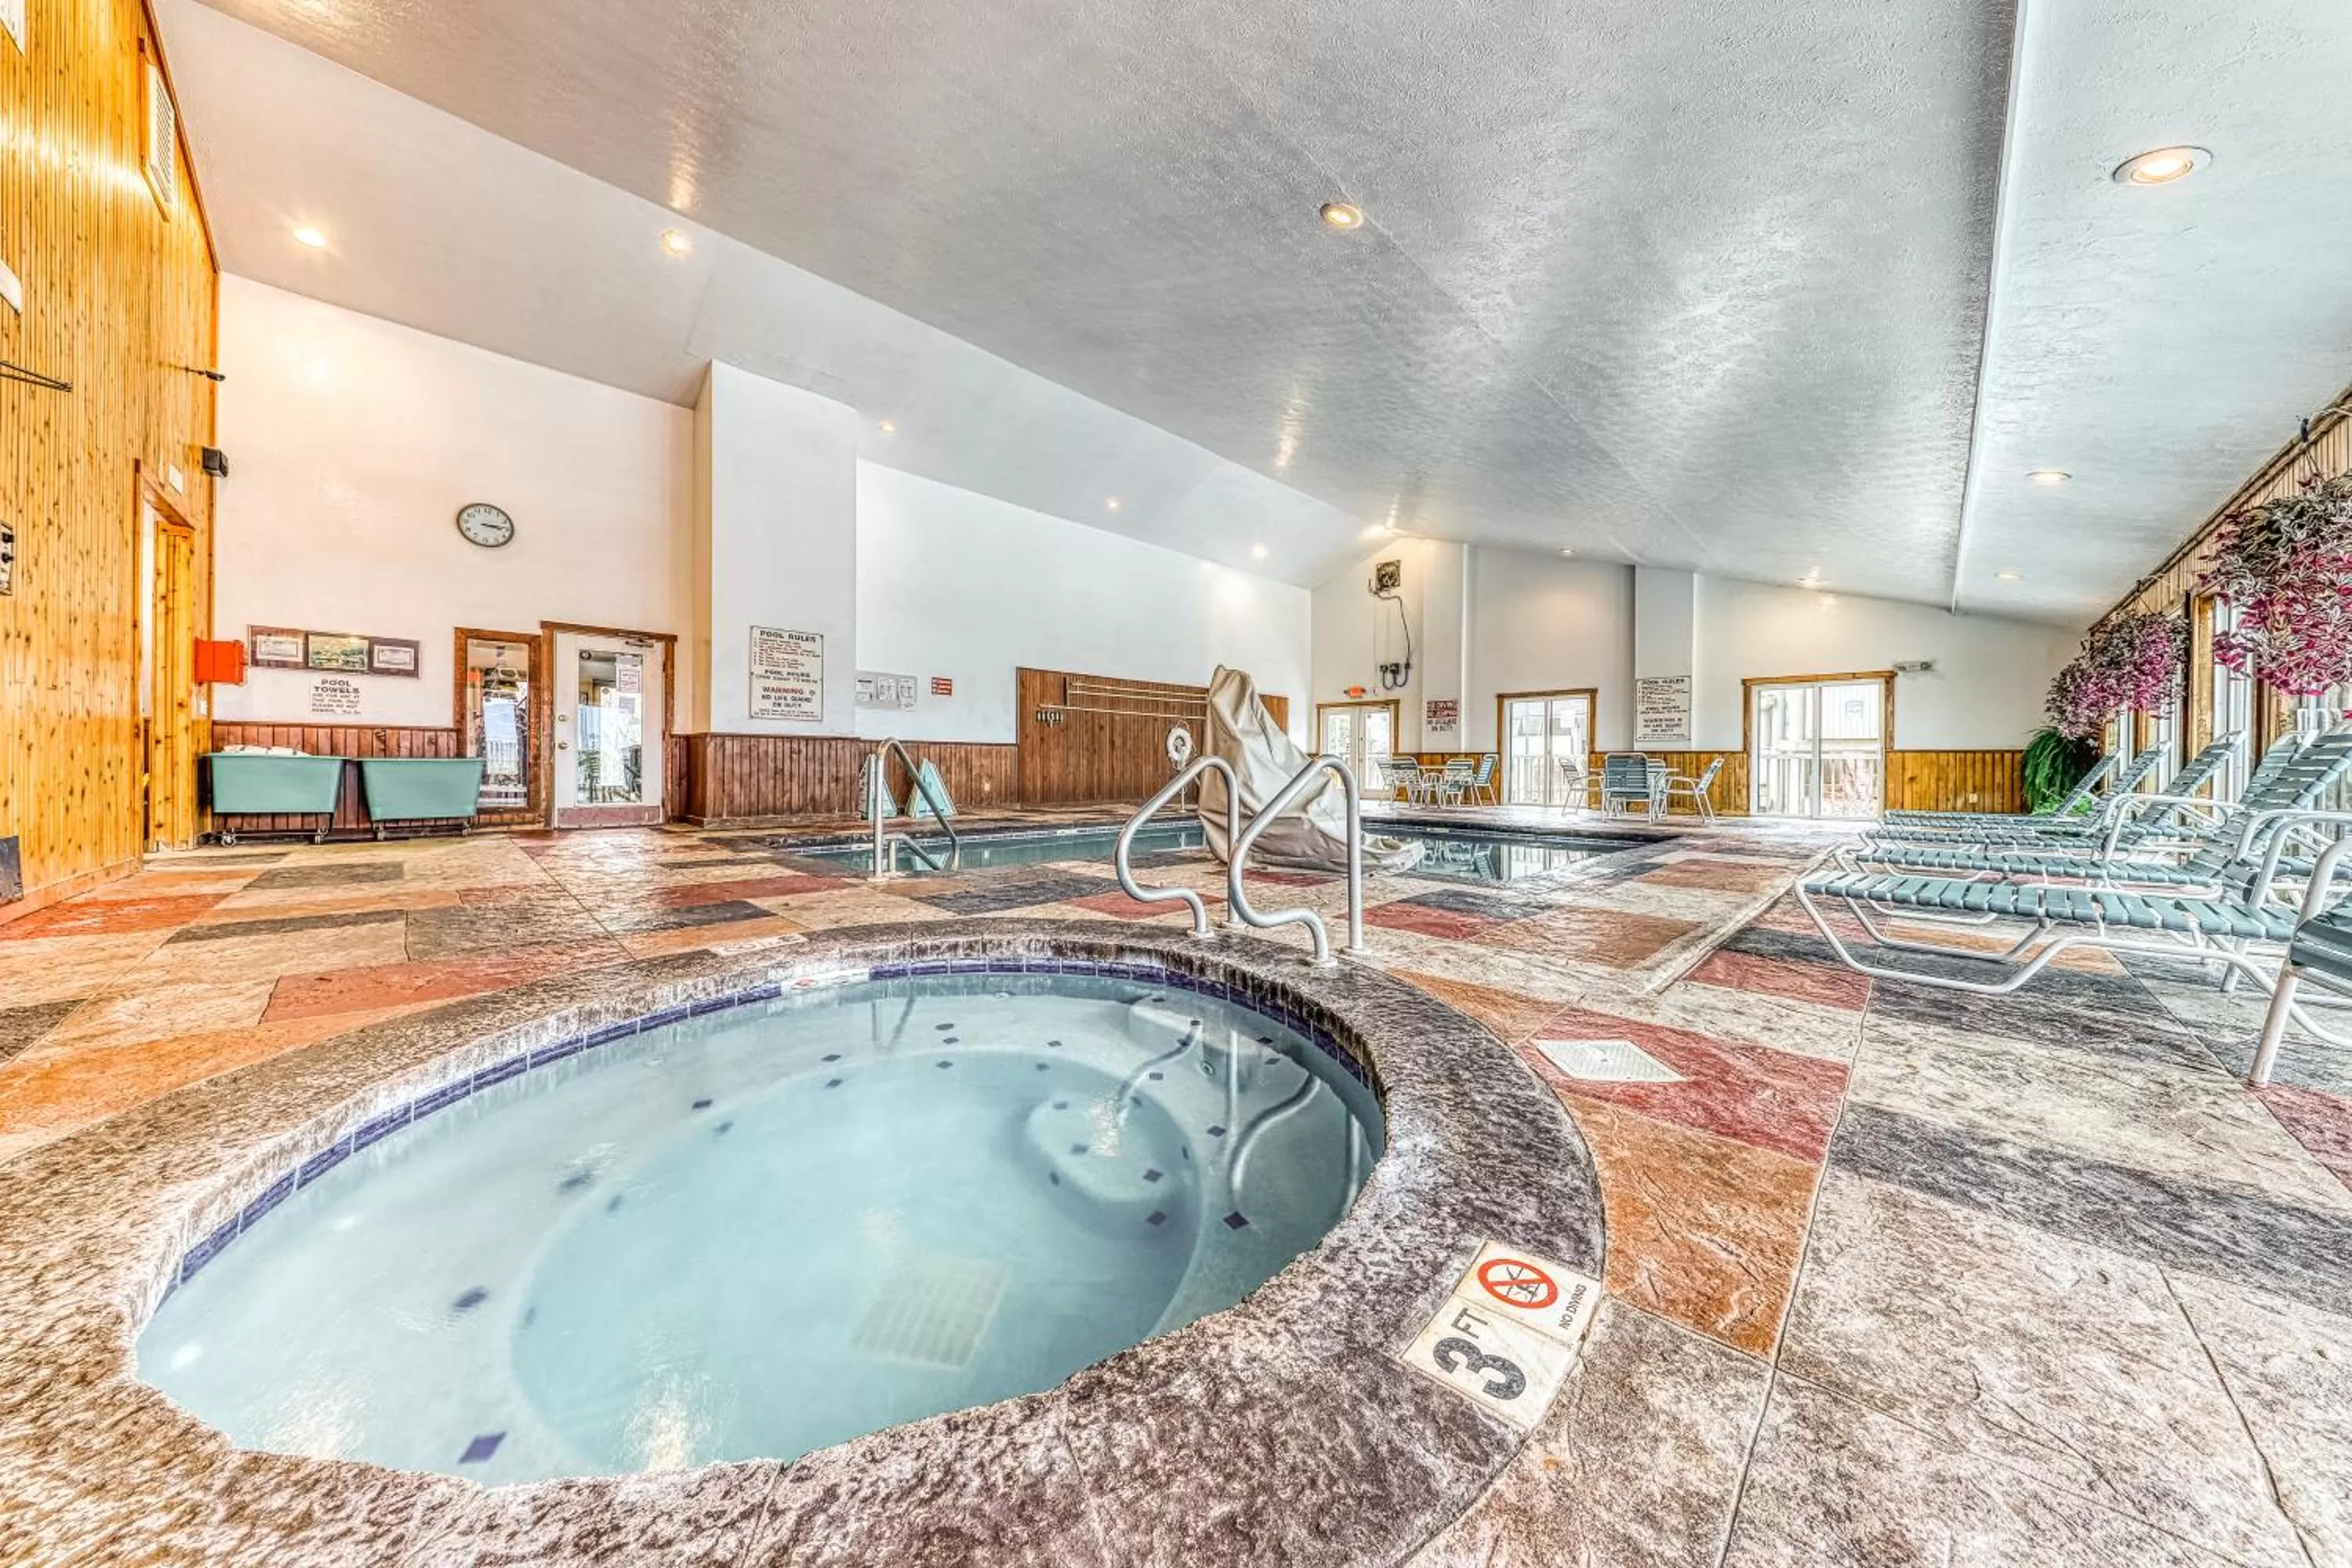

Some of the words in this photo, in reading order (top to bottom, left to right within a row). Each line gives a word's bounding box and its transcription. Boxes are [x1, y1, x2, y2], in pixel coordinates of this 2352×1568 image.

[788, 633, 815, 642] RULES
[1450, 1307, 1488, 1339] FT
[1558, 1312, 1573, 1330] NO
[1566, 1283, 1587, 1315] DIVING
[1433, 1337, 1526, 1401] 3
